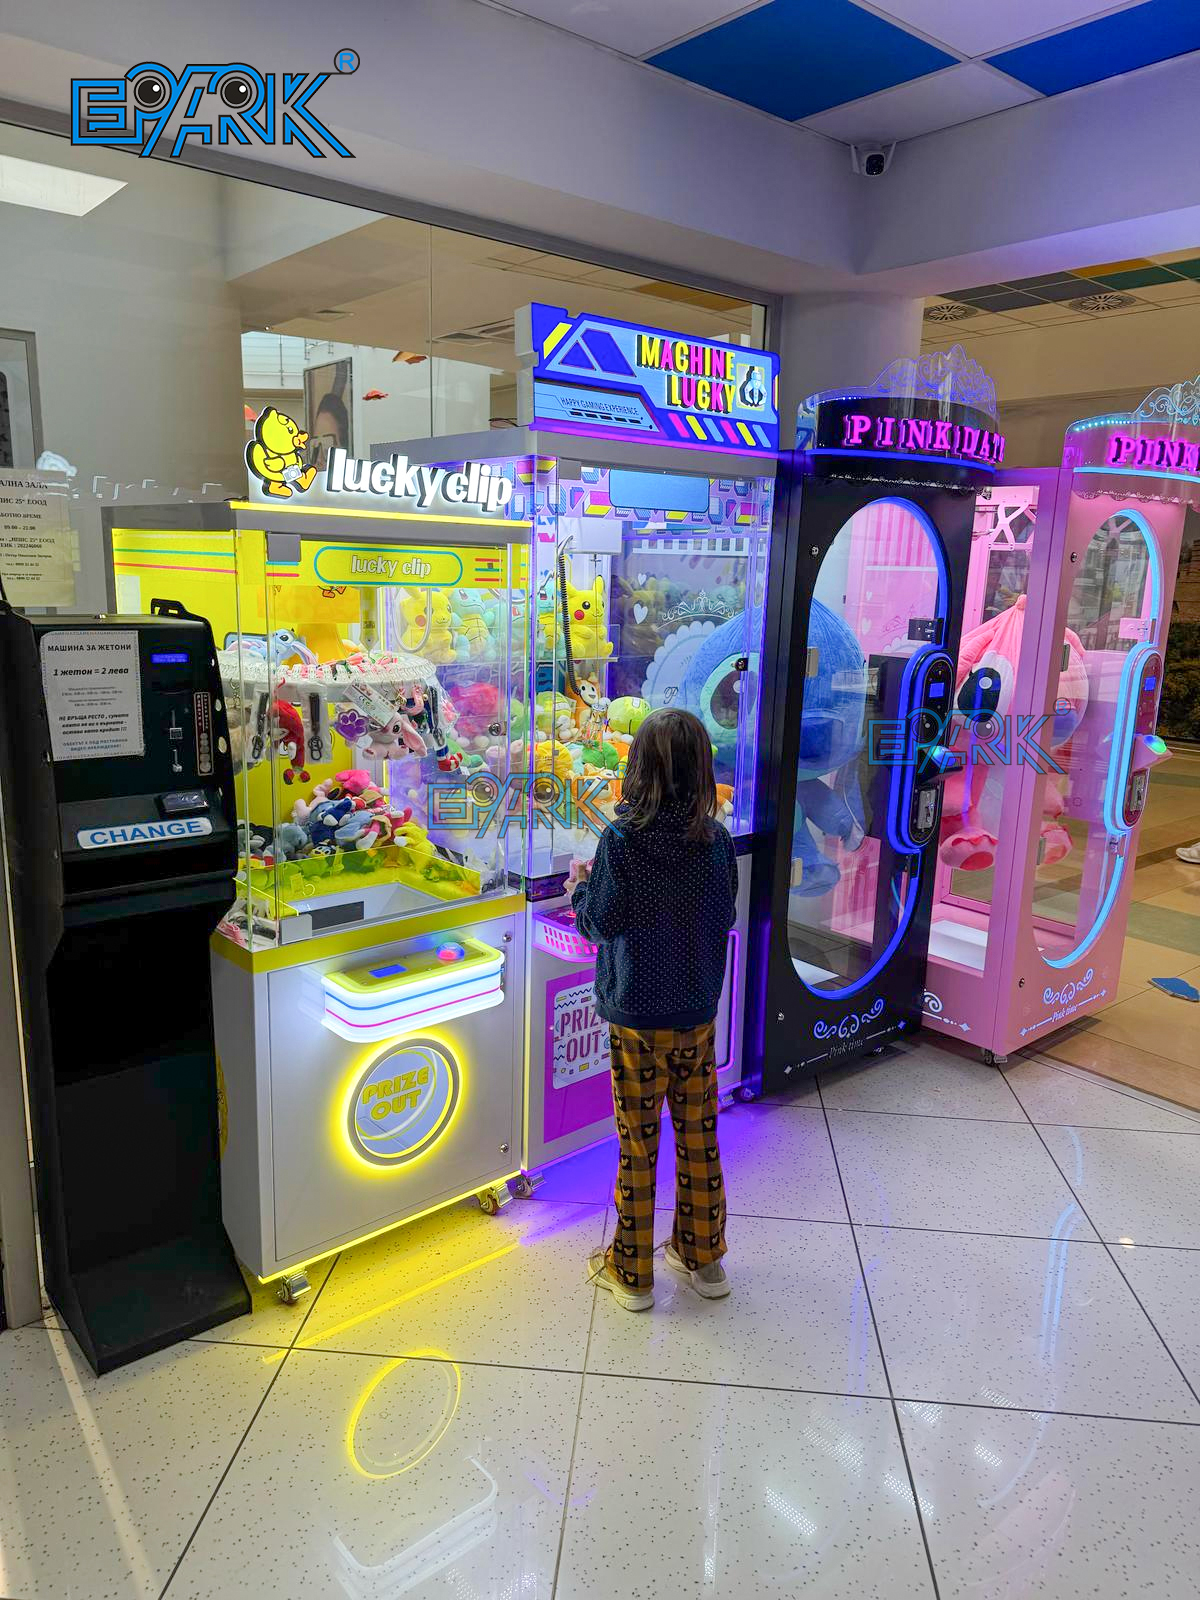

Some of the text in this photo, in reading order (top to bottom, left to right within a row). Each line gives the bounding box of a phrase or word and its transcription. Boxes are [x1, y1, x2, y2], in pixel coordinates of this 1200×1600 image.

[637, 335, 735, 381] MACHINE
[560, 397, 639, 415] HAPPY GAMING EXPERIENCE
[667, 375, 735, 414] LUCKY
[351, 555, 431, 578] lucky clip
[48, 644, 85, 652] МАШИНА
[53, 668, 58, 676] 1
[60, 668, 93, 676] жетон
[101, 667, 107, 675] 2
[90, 821, 204, 845] CHANGE
[567, 1030, 602, 1062] OUT
[361, 1066, 430, 1105] PRIZE
[370, 1090, 422, 1121] OUT
